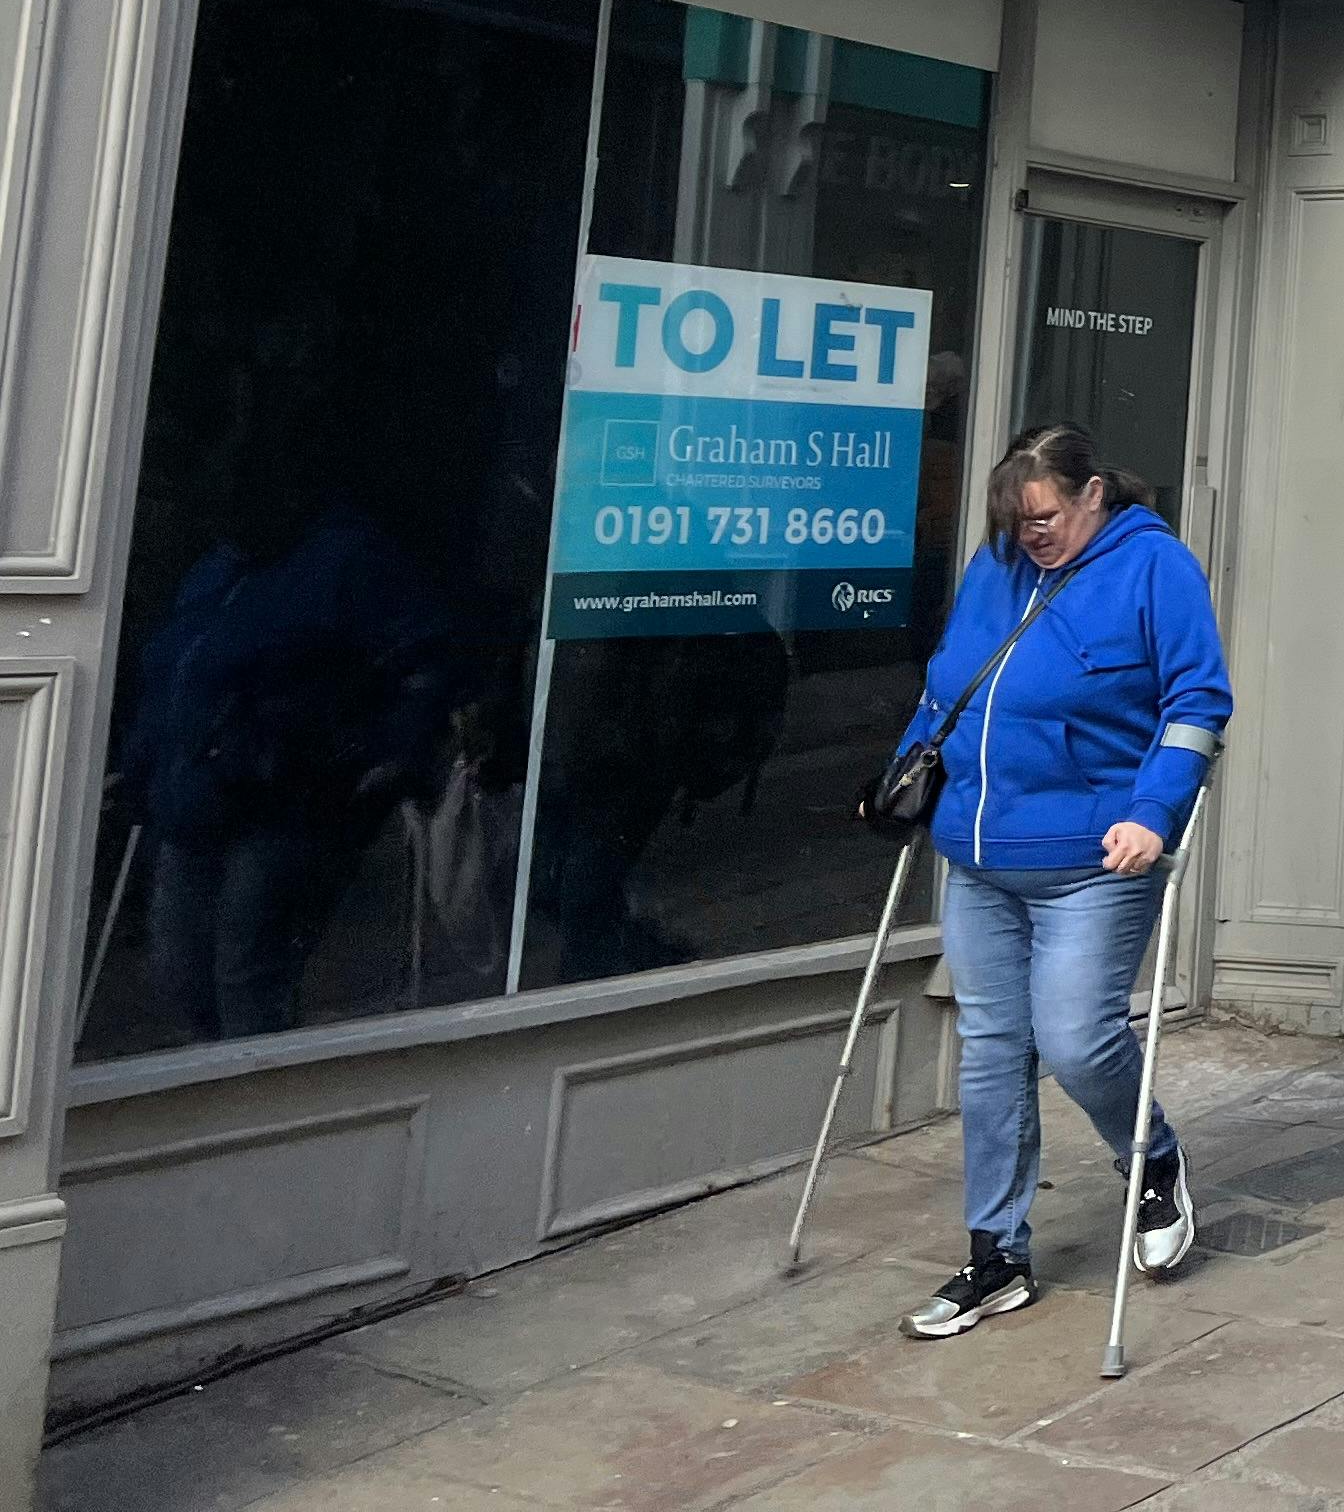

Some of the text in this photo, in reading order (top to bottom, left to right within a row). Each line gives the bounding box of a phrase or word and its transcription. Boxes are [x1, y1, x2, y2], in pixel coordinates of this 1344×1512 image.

[1046, 307, 1153, 335] MIND THE STEP
[600, 283, 916, 384] TO LET
[616, 445, 645, 460] GSH
[667, 424, 891, 469] Graham S Hall
[666, 473, 822, 490] CHARTERED SURVEYORS
[594, 505, 886, 545] 0191 731 8660
[574, 590, 757, 611] www.grahamshall.com
[857, 589, 892, 603] RICS
